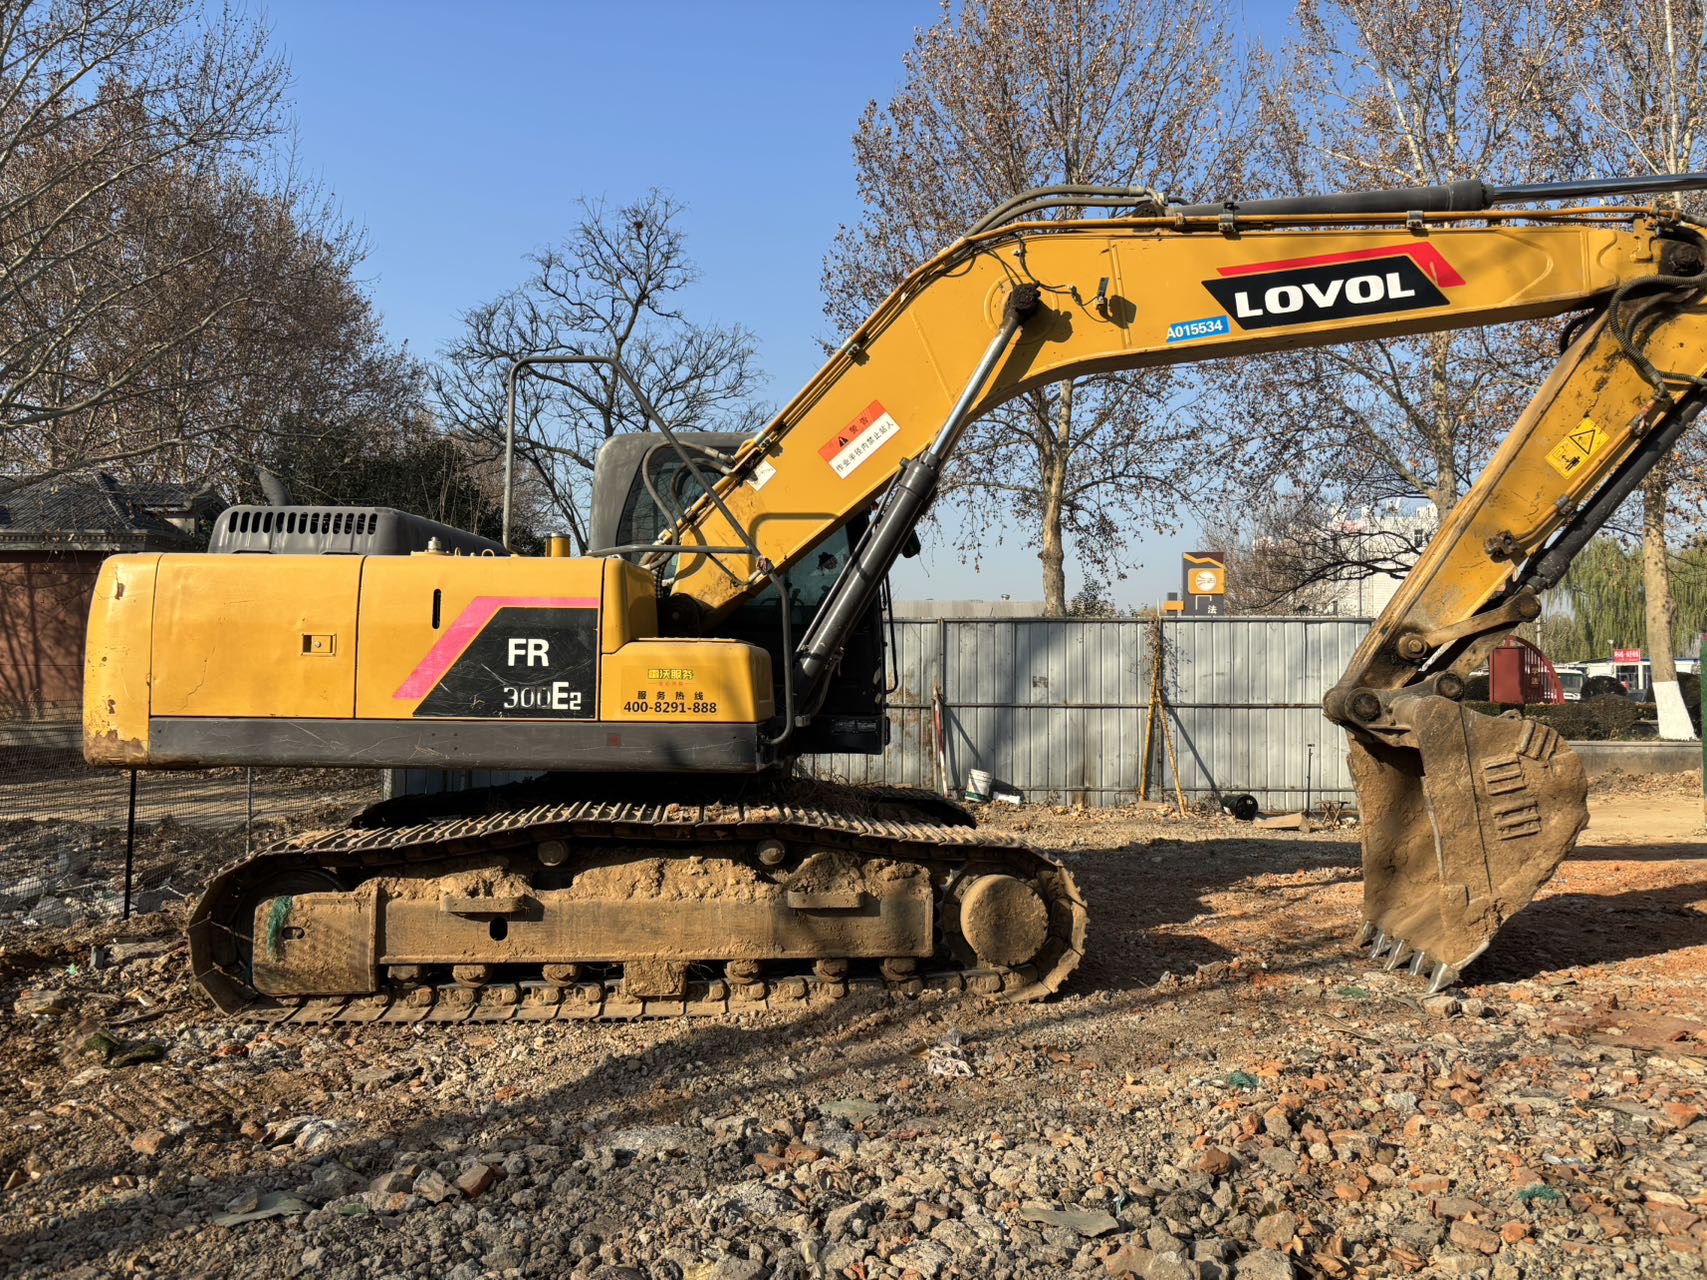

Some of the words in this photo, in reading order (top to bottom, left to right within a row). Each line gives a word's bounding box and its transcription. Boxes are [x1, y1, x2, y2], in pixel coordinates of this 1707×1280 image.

[1235, 272, 1415, 318] LOVOL
[1167, 320, 1223, 338] A015534
[849, 416, 869, 434] 警告
[836, 421, 894, 472] 作业半径内禁止站人
[507, 638, 549, 667] FR
[503, 681, 582, 710] 300E2
[623, 701, 717, 713] 400-8291-888
